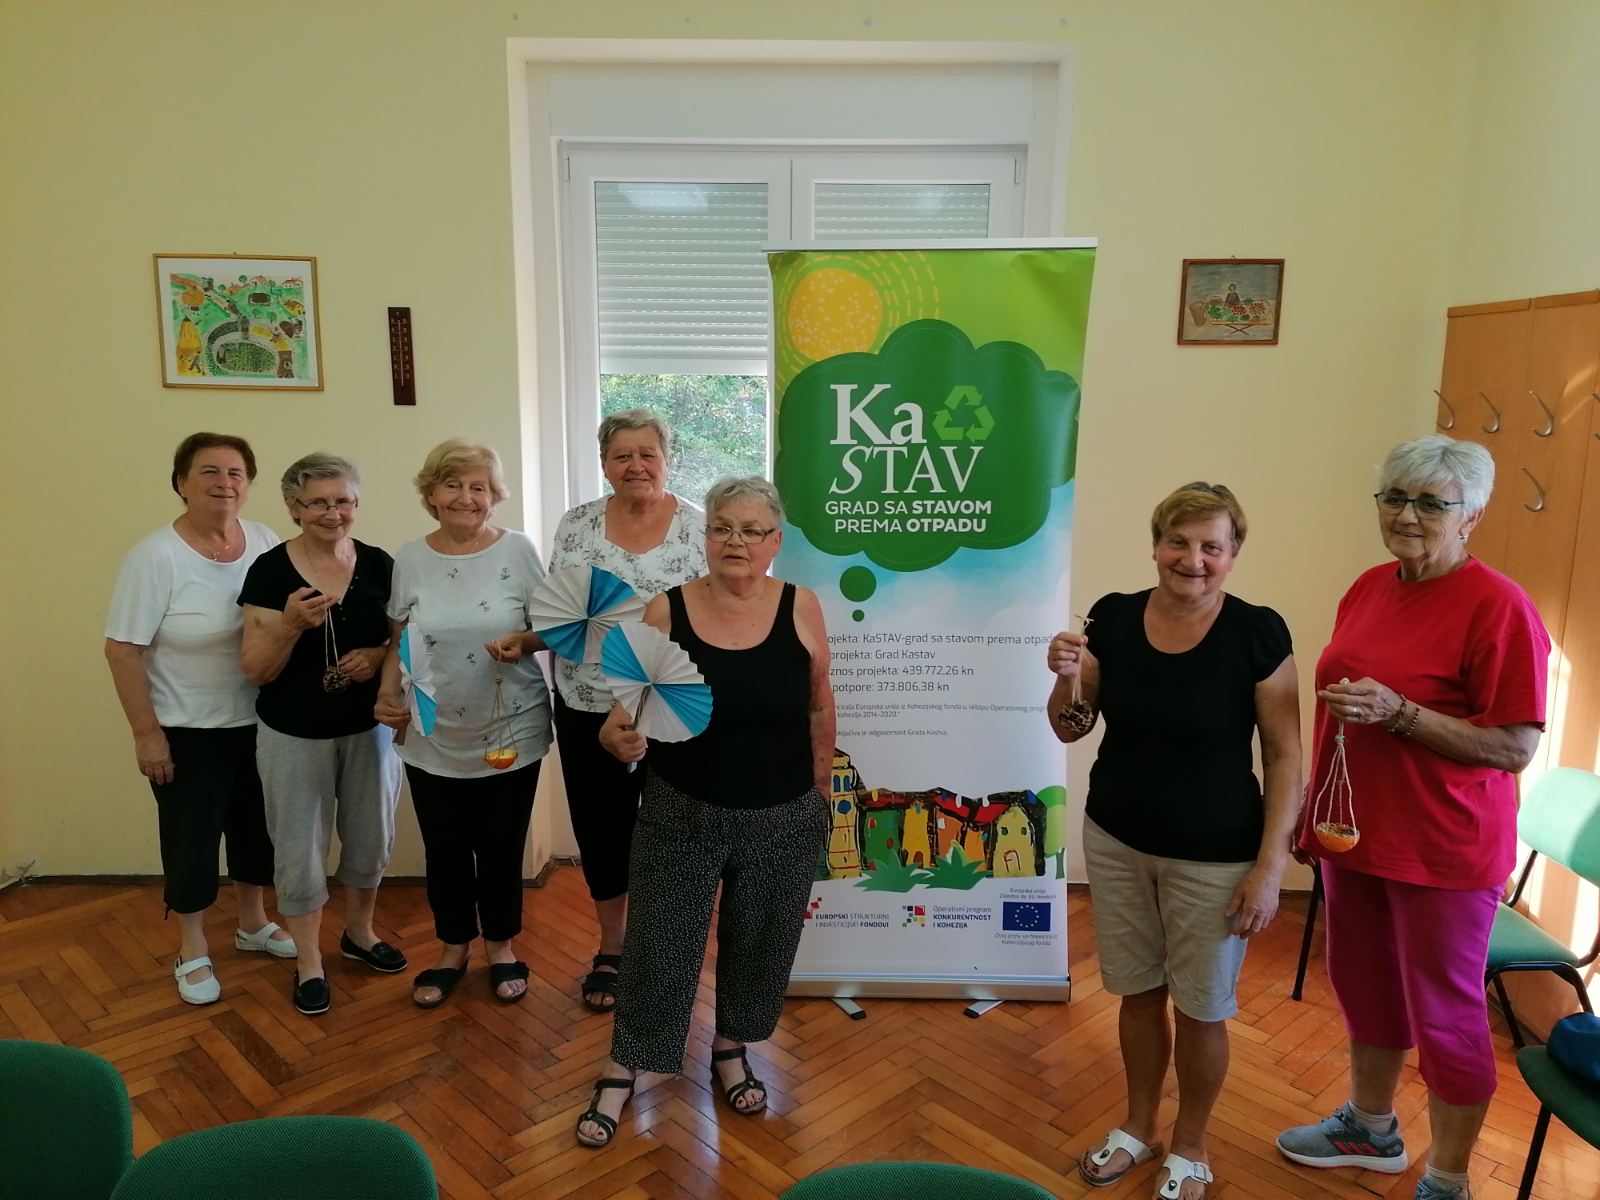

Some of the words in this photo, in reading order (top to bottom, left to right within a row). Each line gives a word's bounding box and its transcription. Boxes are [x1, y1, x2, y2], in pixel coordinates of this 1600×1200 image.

[830, 384, 927, 445] Ka
[828, 445, 984, 494] STAV
[825, 500, 879, 514] GRAD
[884, 500, 908, 514] SA
[912, 500, 991, 514] STAVOM
[835, 518, 902, 533] PREMA
[906, 518, 987, 533] OTPADU
[827, 634, 860, 645] ojekta:
[863, 633, 928, 645] KaSTAV-grad
[931, 635, 943, 643] sa
[946, 634, 984, 643] stavom
[988, 635, 1021, 646] prema
[1024, 634, 1053, 646] otpad
[875, 649, 899, 659] Grad
[902, 650, 936, 659] Kastav
[830, 667, 854, 676] znos
[857, 665, 900, 678] projekta:
[962, 665, 974, 675] kn
[832, 683, 874, 694] potpore:
[877, 682, 934, 692] 373.806,38
[938, 682, 950, 691] kn
[933, 905, 965, 913] Operativni
[966, 906, 991, 914] program
